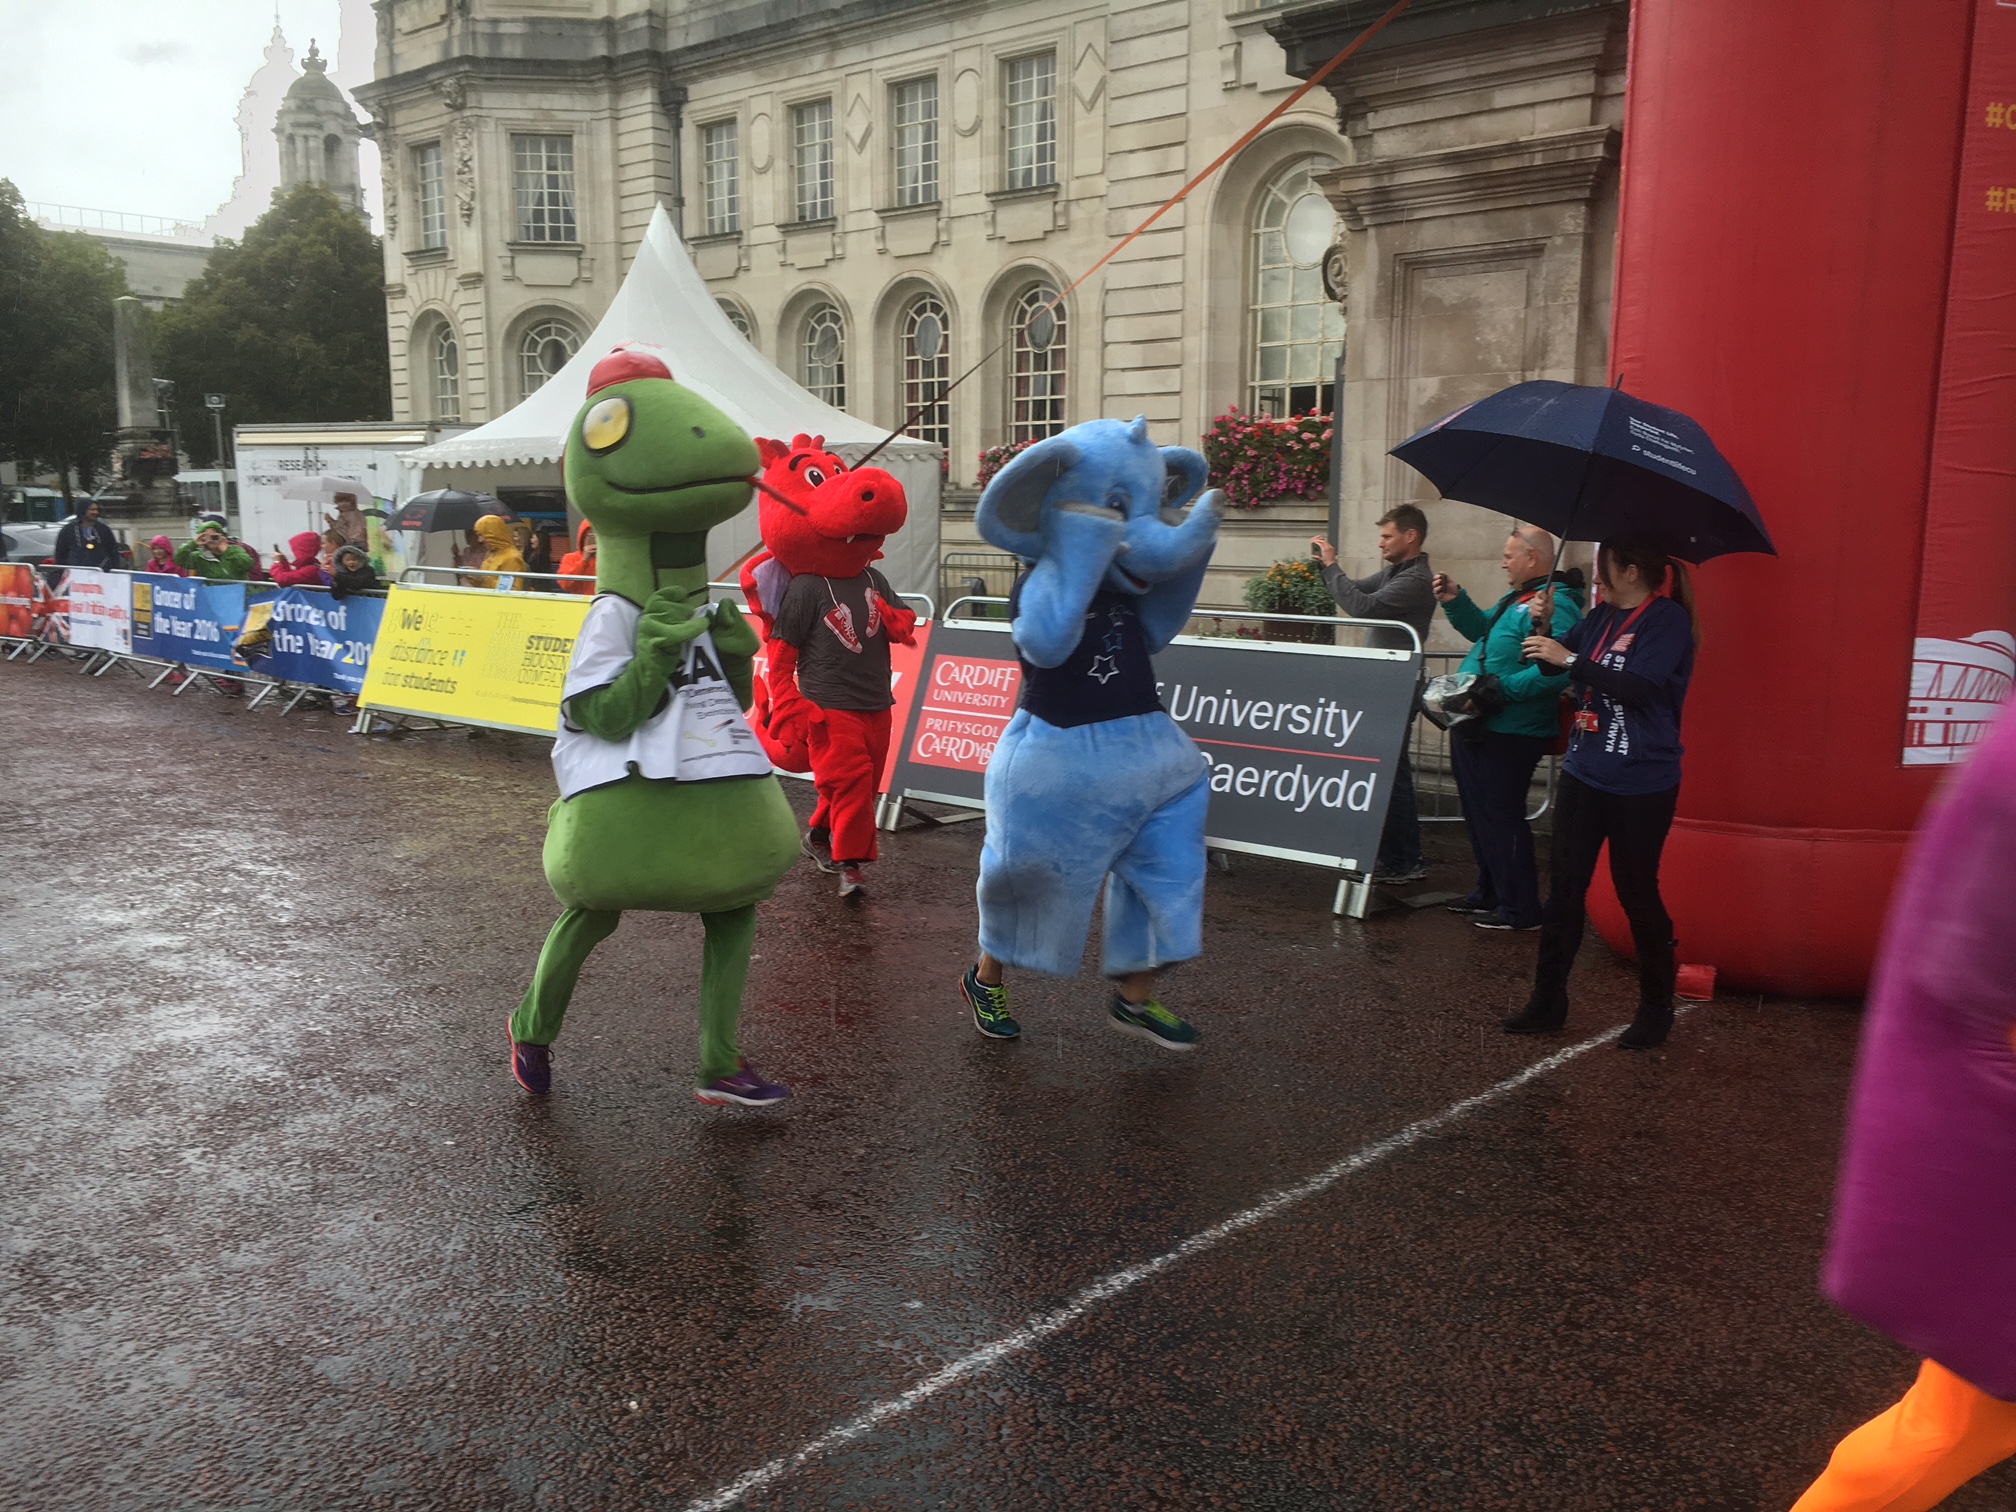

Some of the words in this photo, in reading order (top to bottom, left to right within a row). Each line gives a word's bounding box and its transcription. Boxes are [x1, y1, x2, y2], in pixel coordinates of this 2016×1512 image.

[327, 605, 347, 631] of
[272, 627, 304, 654] the
[935, 661, 1020, 692] CARDIFF
[932, 688, 1010, 708] UNIVERSITY
[924, 717, 1000, 738] PRIFYSGOL
[1169, 684, 1363, 748] University
